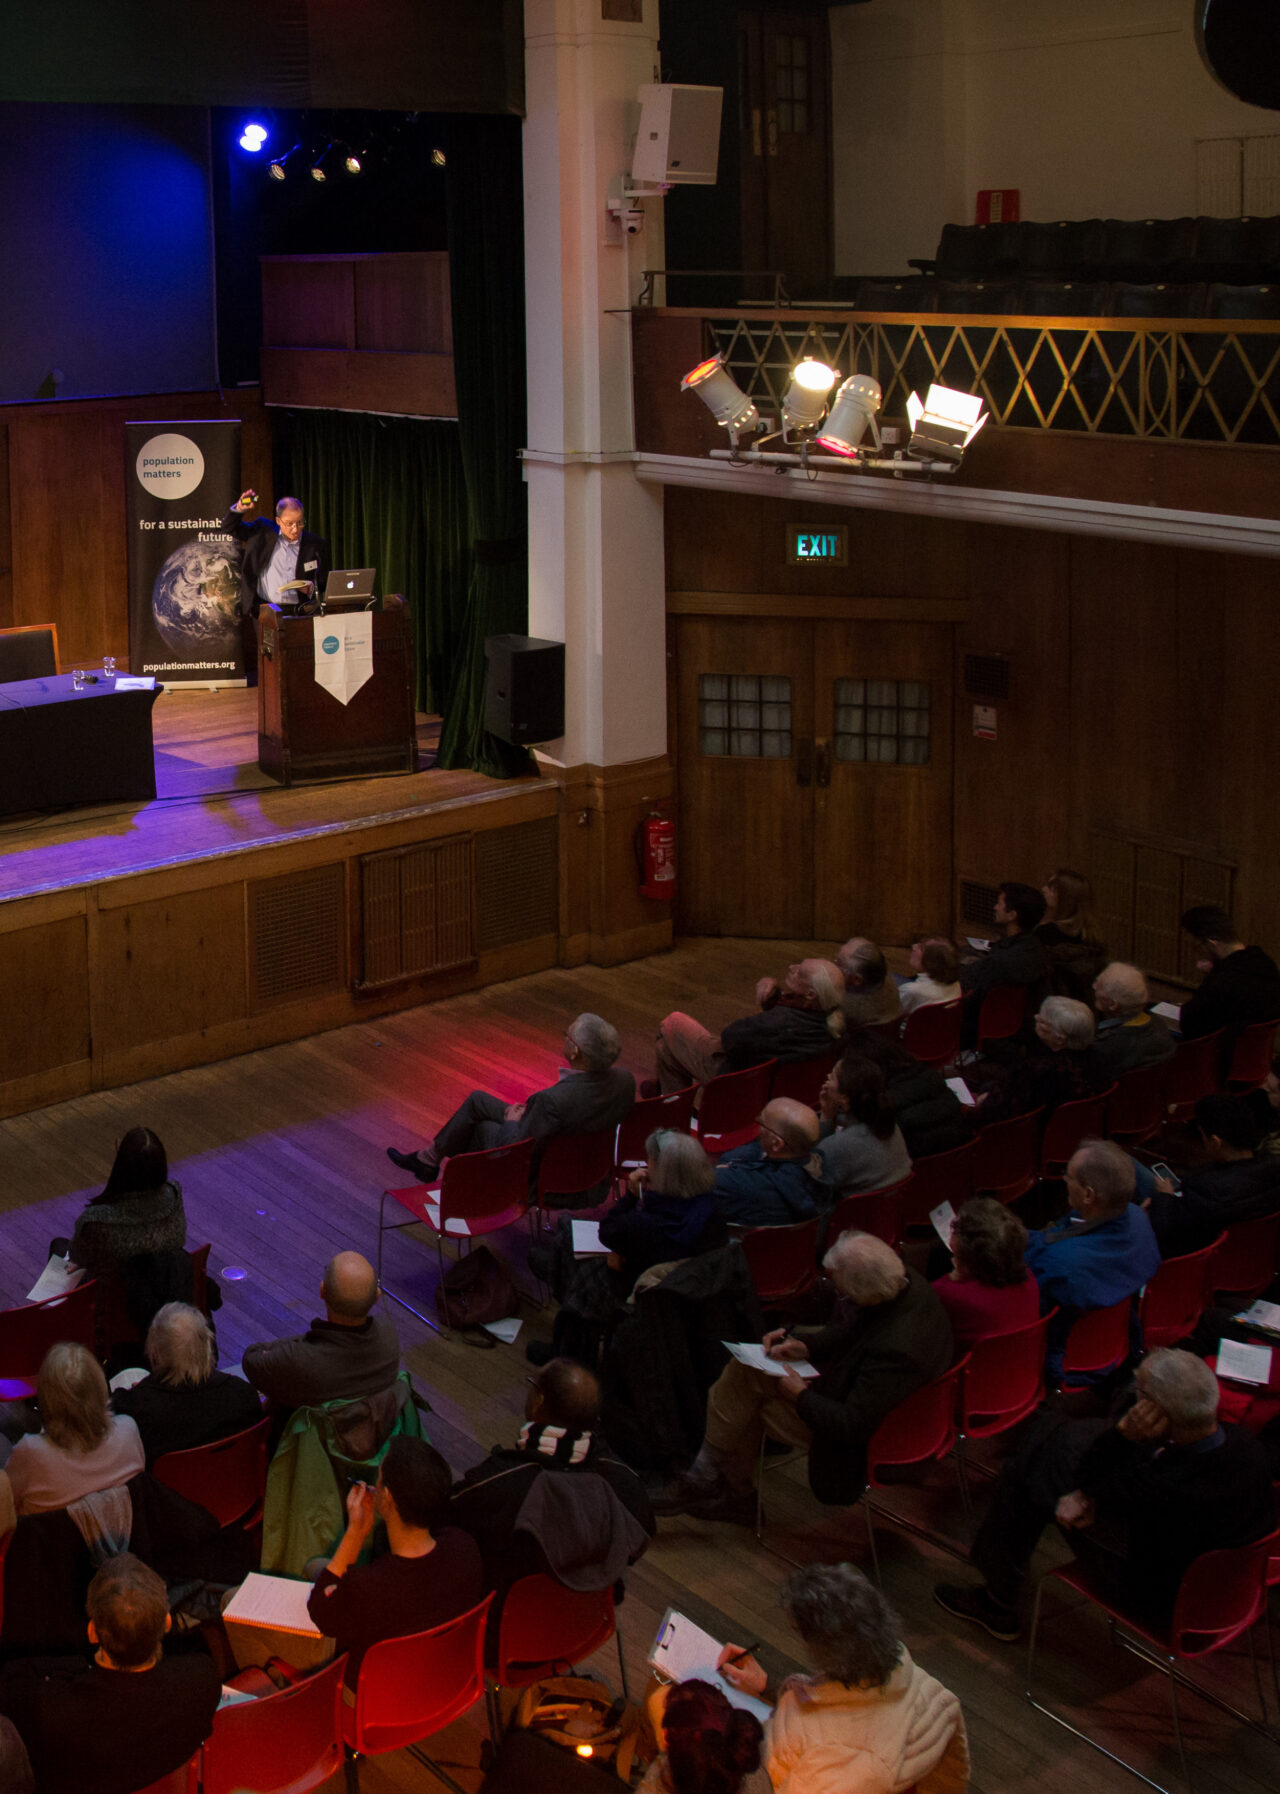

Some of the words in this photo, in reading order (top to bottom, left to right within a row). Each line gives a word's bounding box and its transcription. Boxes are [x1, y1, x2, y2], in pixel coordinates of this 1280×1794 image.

[143, 457, 195, 468] population
[143, 470, 182, 479] matters
[139, 519, 157, 530] for
[158, 521, 166, 530] a
[167, 517, 224, 529] sustainab
[797, 534, 838, 557] EXIT
[143, 661, 236, 673] populationmatters.org
